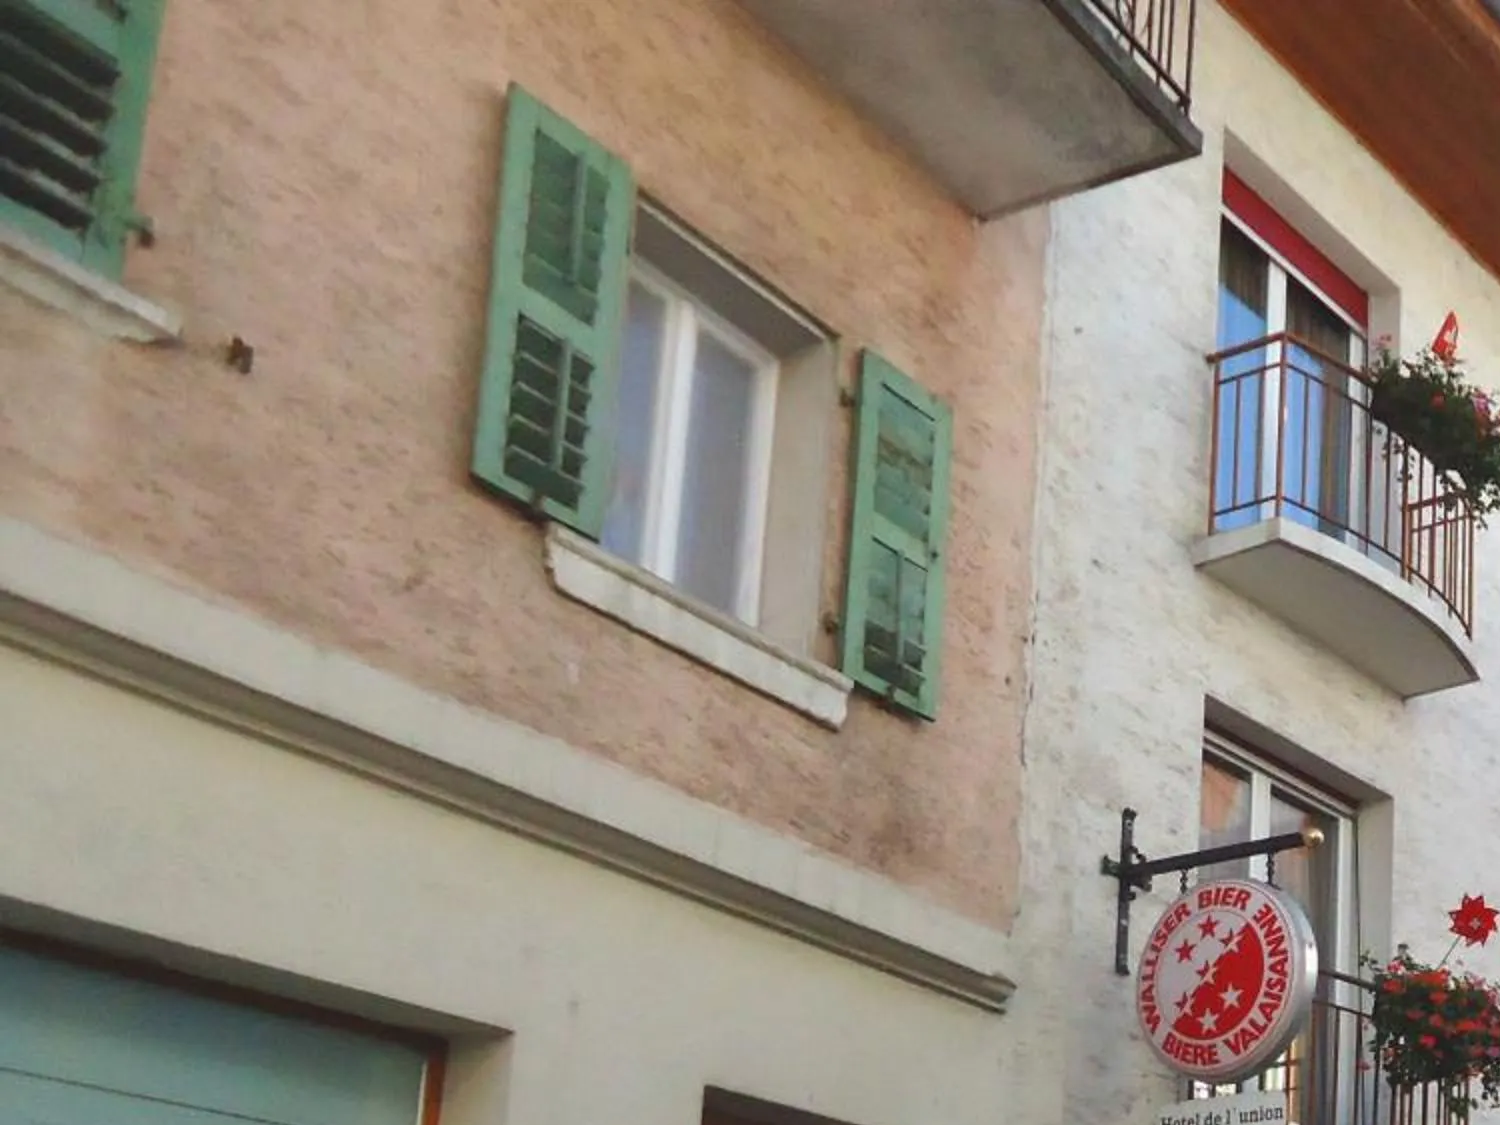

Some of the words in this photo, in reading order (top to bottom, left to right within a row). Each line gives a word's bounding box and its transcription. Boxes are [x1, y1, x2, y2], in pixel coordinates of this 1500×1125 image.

[1141, 903, 1192, 1035] WALLISER
[1198, 887, 1251, 911] BIER
[1162, 1031, 1220, 1066] BIERE
[1223, 904, 1288, 1056] VALAISANNE
